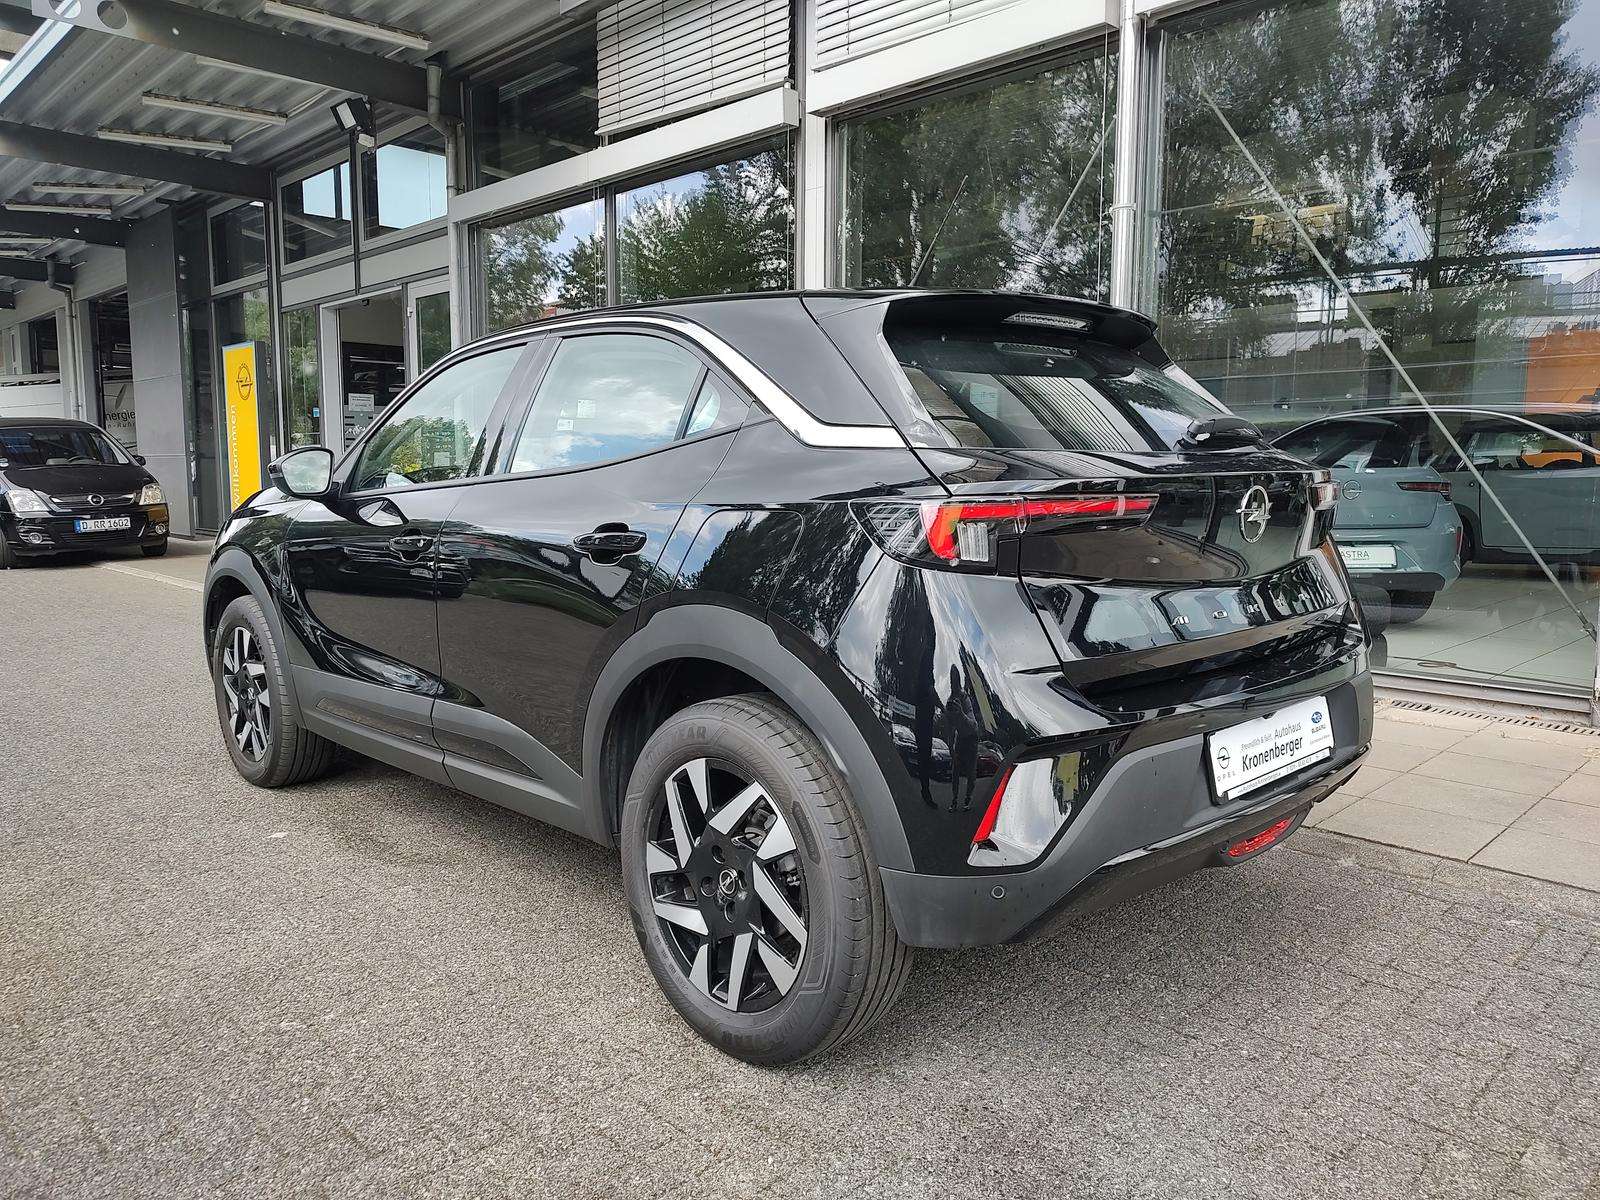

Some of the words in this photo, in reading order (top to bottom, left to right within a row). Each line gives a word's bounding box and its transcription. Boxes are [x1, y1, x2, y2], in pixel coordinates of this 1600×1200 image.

[1340, 550, 1370, 558] ASTRA
[1274, 721, 1302, 739] Autohaus
[1242, 736, 1303, 772] Kronenberger
[1217, 770, 1236, 782] OPEL
